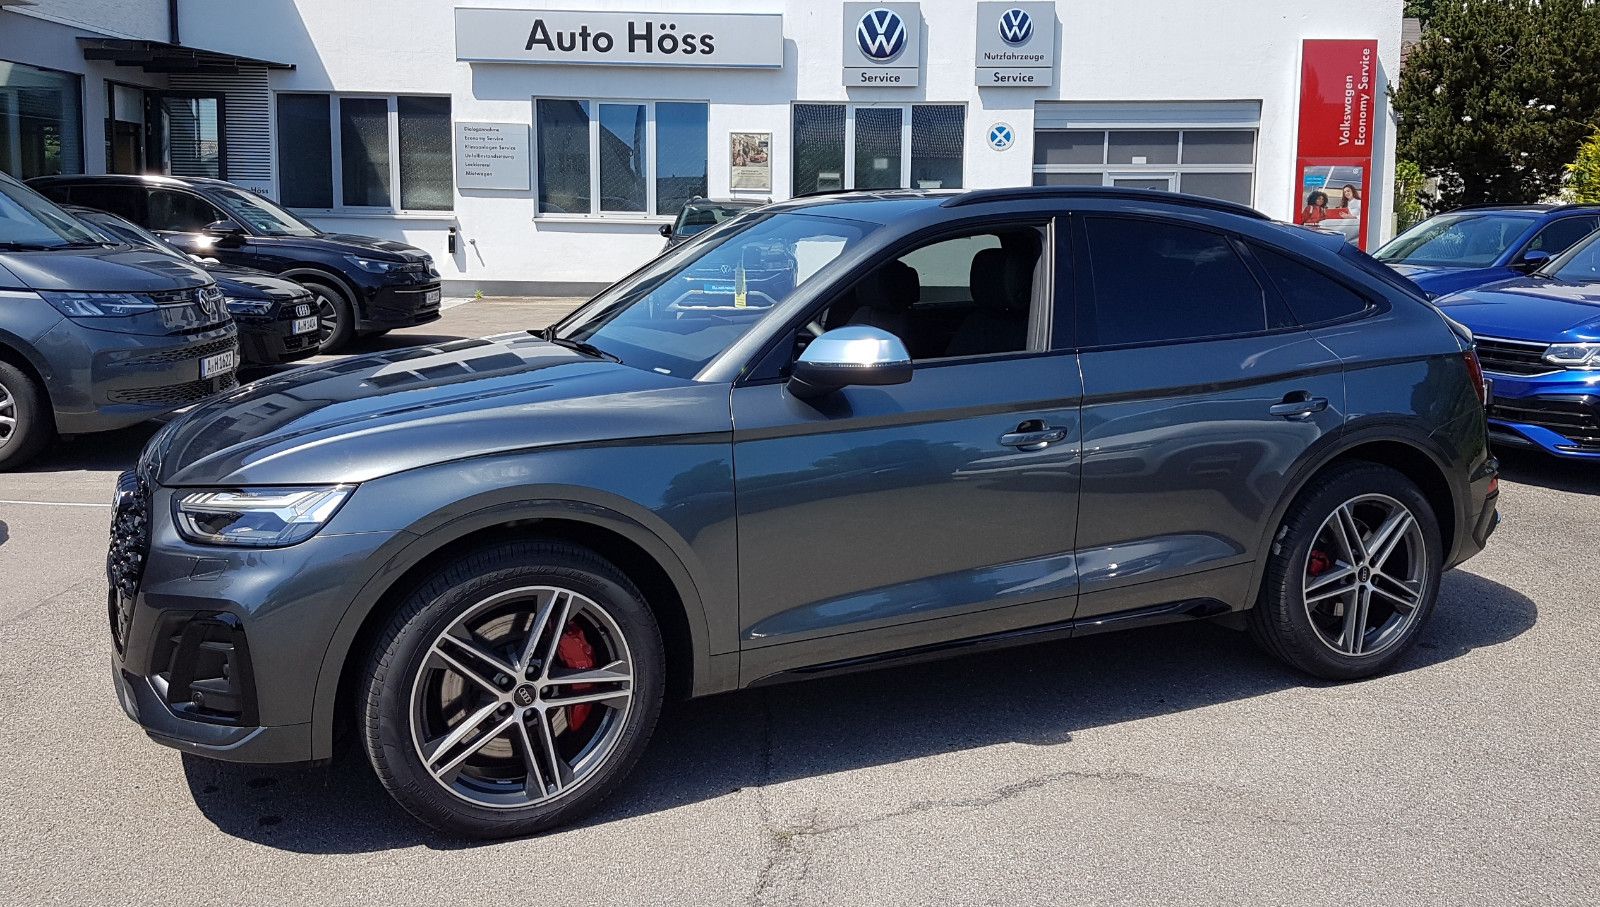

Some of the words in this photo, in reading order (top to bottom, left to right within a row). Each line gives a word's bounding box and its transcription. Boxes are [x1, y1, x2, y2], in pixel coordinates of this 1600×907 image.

[525, 19, 614, 53] Auto
[628, 21, 715, 55] Höss
[984, 52, 1045, 61] Nutzfahrzeuge
[1359, 47, 1370, 90] Service
[860, 72, 901, 83] Service
[993, 72, 1034, 83] Service
[1339, 75, 1355, 146] Volkswagen
[1354, 93, 1370, 146] Economy
